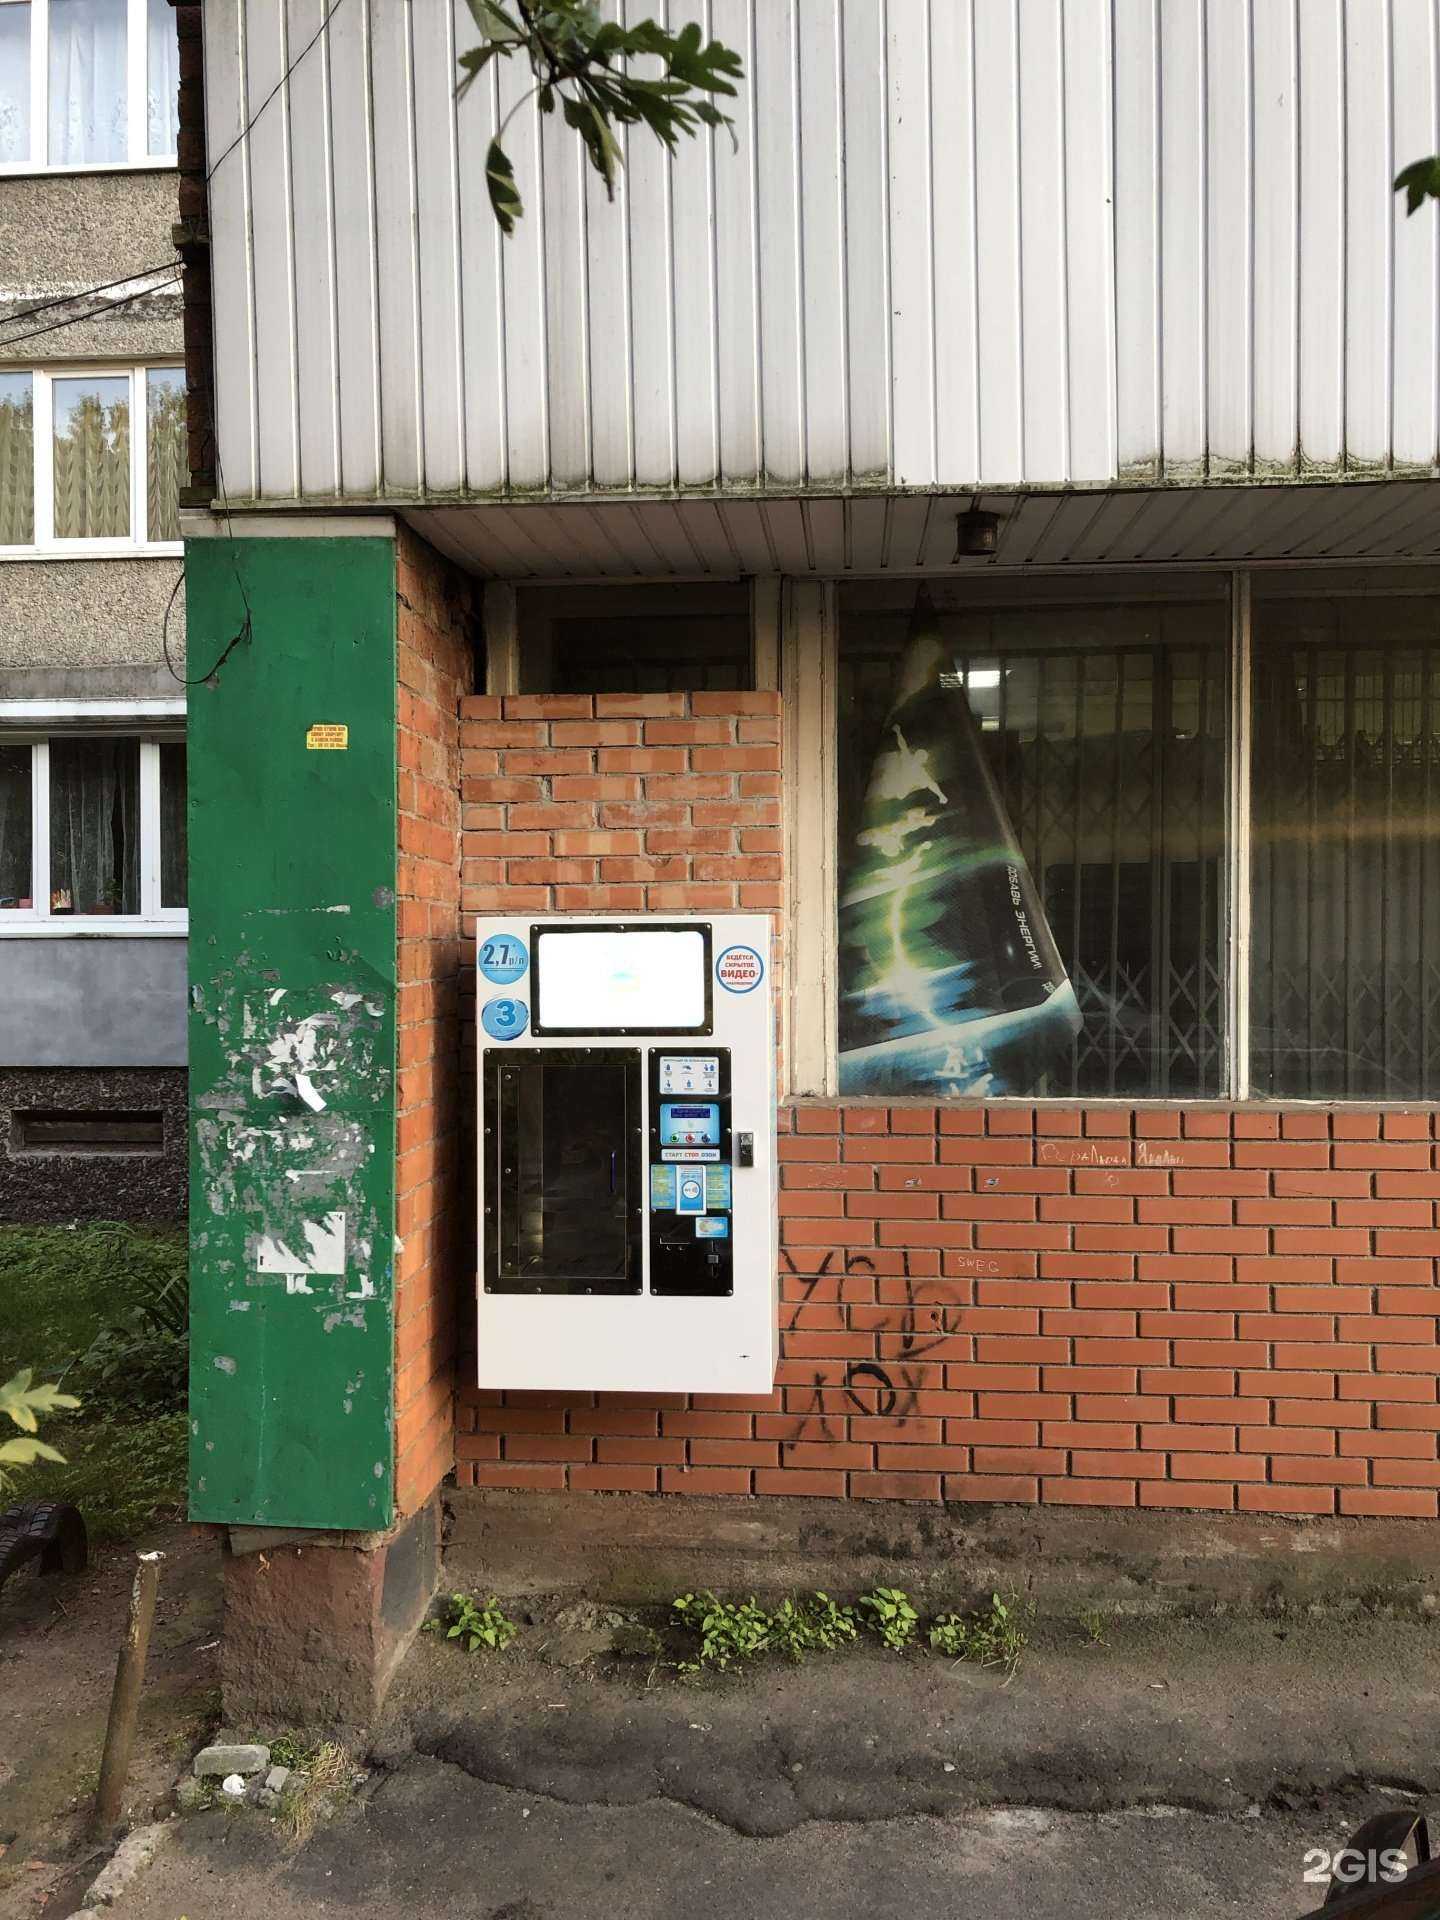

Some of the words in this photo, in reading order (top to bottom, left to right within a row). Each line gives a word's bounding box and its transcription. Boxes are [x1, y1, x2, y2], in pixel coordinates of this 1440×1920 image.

[1007, 865, 1022, 906] ДОБАВЬ
[1015, 911, 1042, 970] ЭНЕРГИИ!
[495, 1000, 516, 1027] 3
